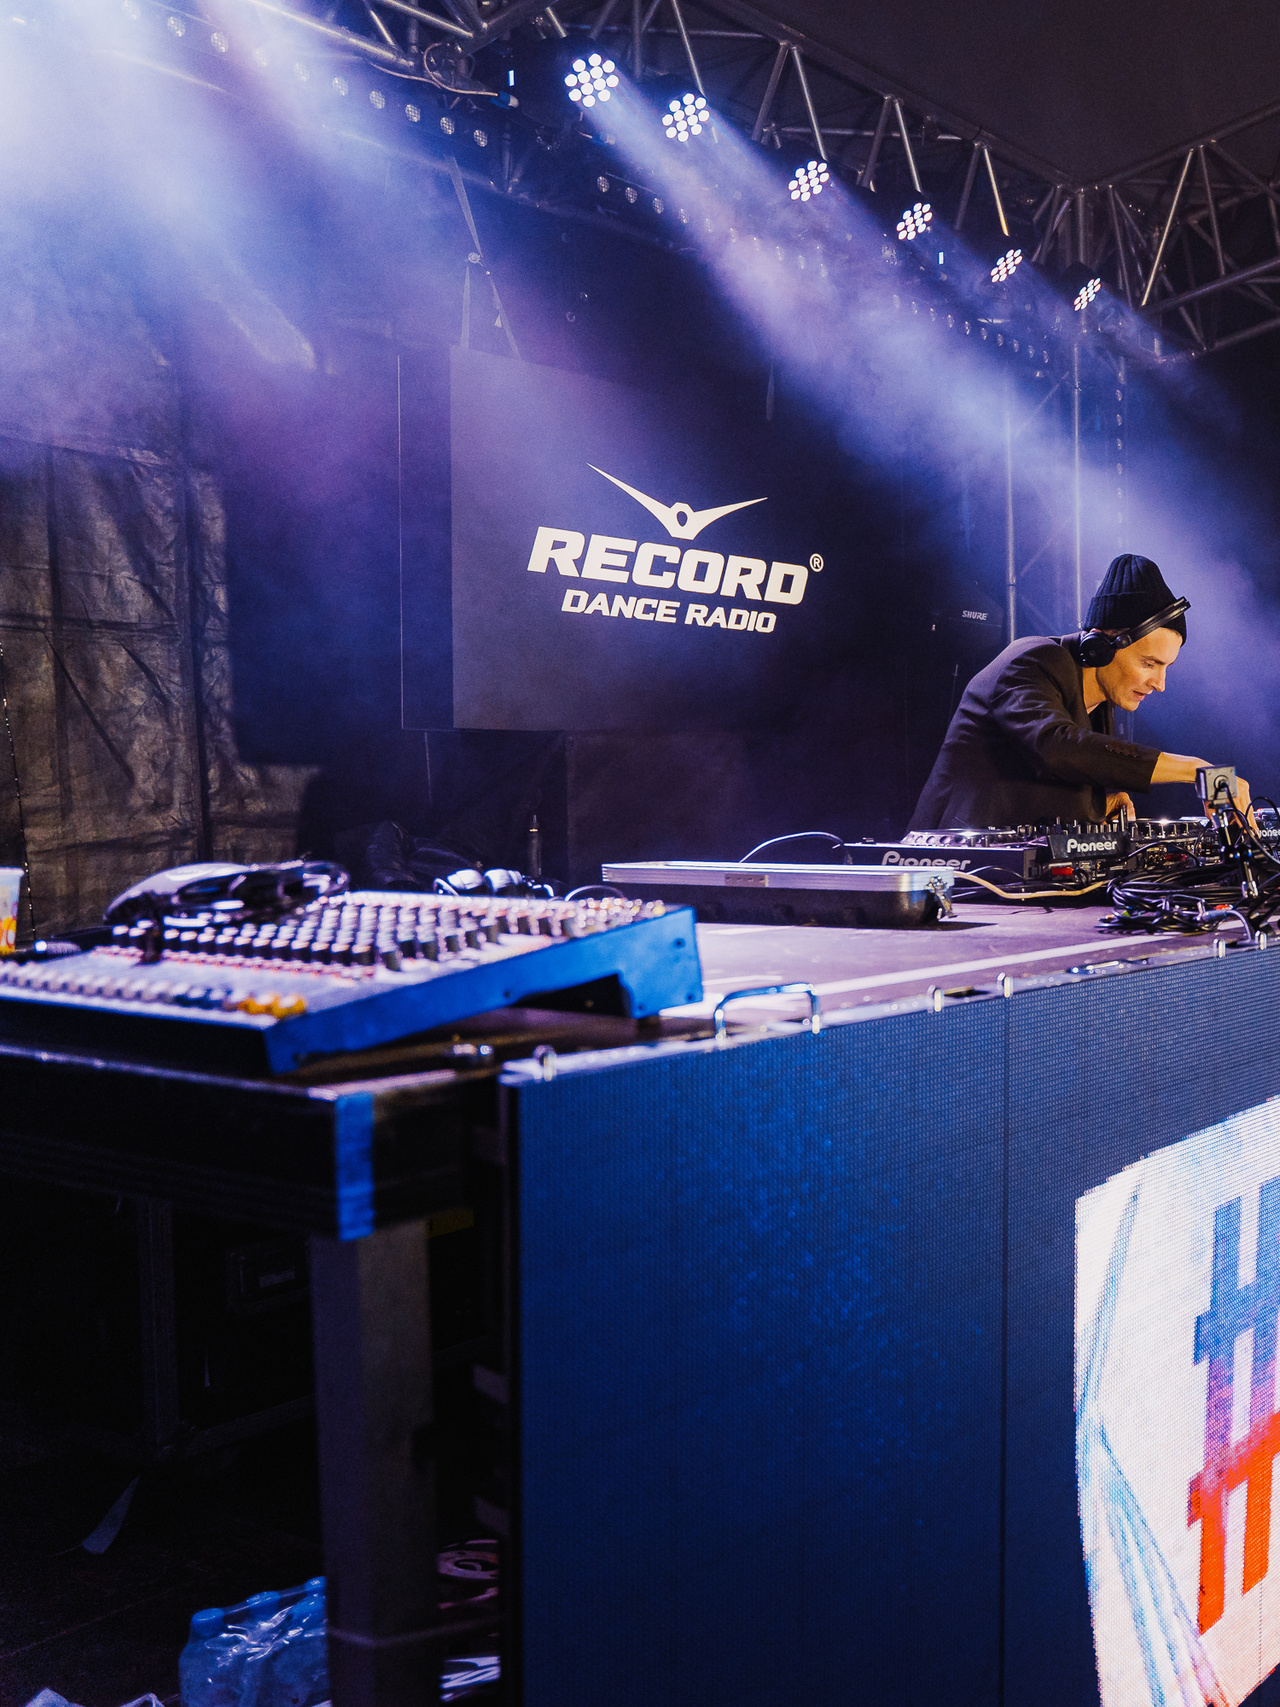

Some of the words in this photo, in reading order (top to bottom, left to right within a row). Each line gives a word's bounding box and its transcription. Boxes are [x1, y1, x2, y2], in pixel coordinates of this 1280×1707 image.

[561, 589, 681, 623] DANCE
[684, 604, 777, 633] RADIO
[962, 610, 988, 620] SHURE
[1067, 838, 1117, 853] Pioneer
[882, 850, 971, 870] Pioneer
